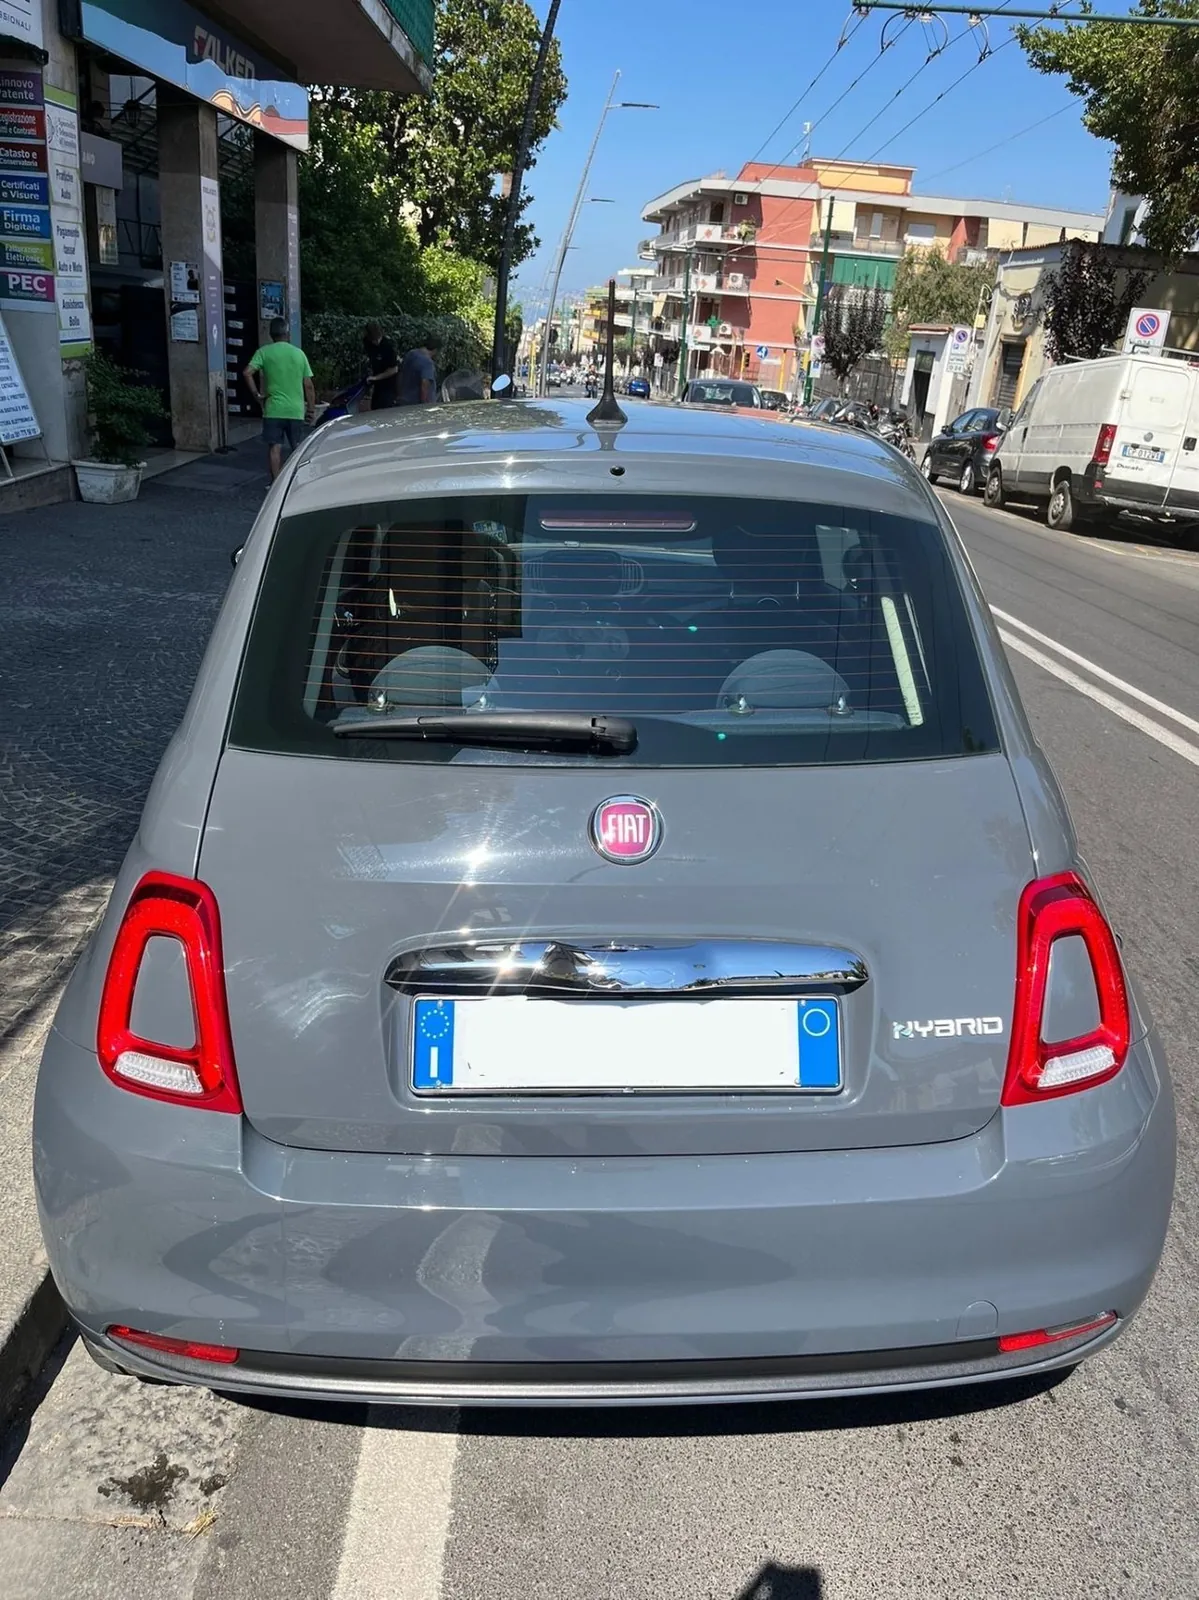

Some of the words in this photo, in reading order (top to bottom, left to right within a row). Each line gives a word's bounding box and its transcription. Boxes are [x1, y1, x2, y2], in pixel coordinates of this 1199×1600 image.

[0, 76, 34, 89] innovo
[0, 147, 30, 159] Catasto
[1, 180, 40, 190] Certificati
[10, 190, 40, 200] Visure
[3, 210, 40, 223] Firma
[4, 221, 41, 232] Digitale
[6, 252, 45, 263] Elettronica
[8, 274, 47, 292] PEC
[606, 814, 647, 843] FIAT
[893, 1016, 1003, 1039] HYBRID
